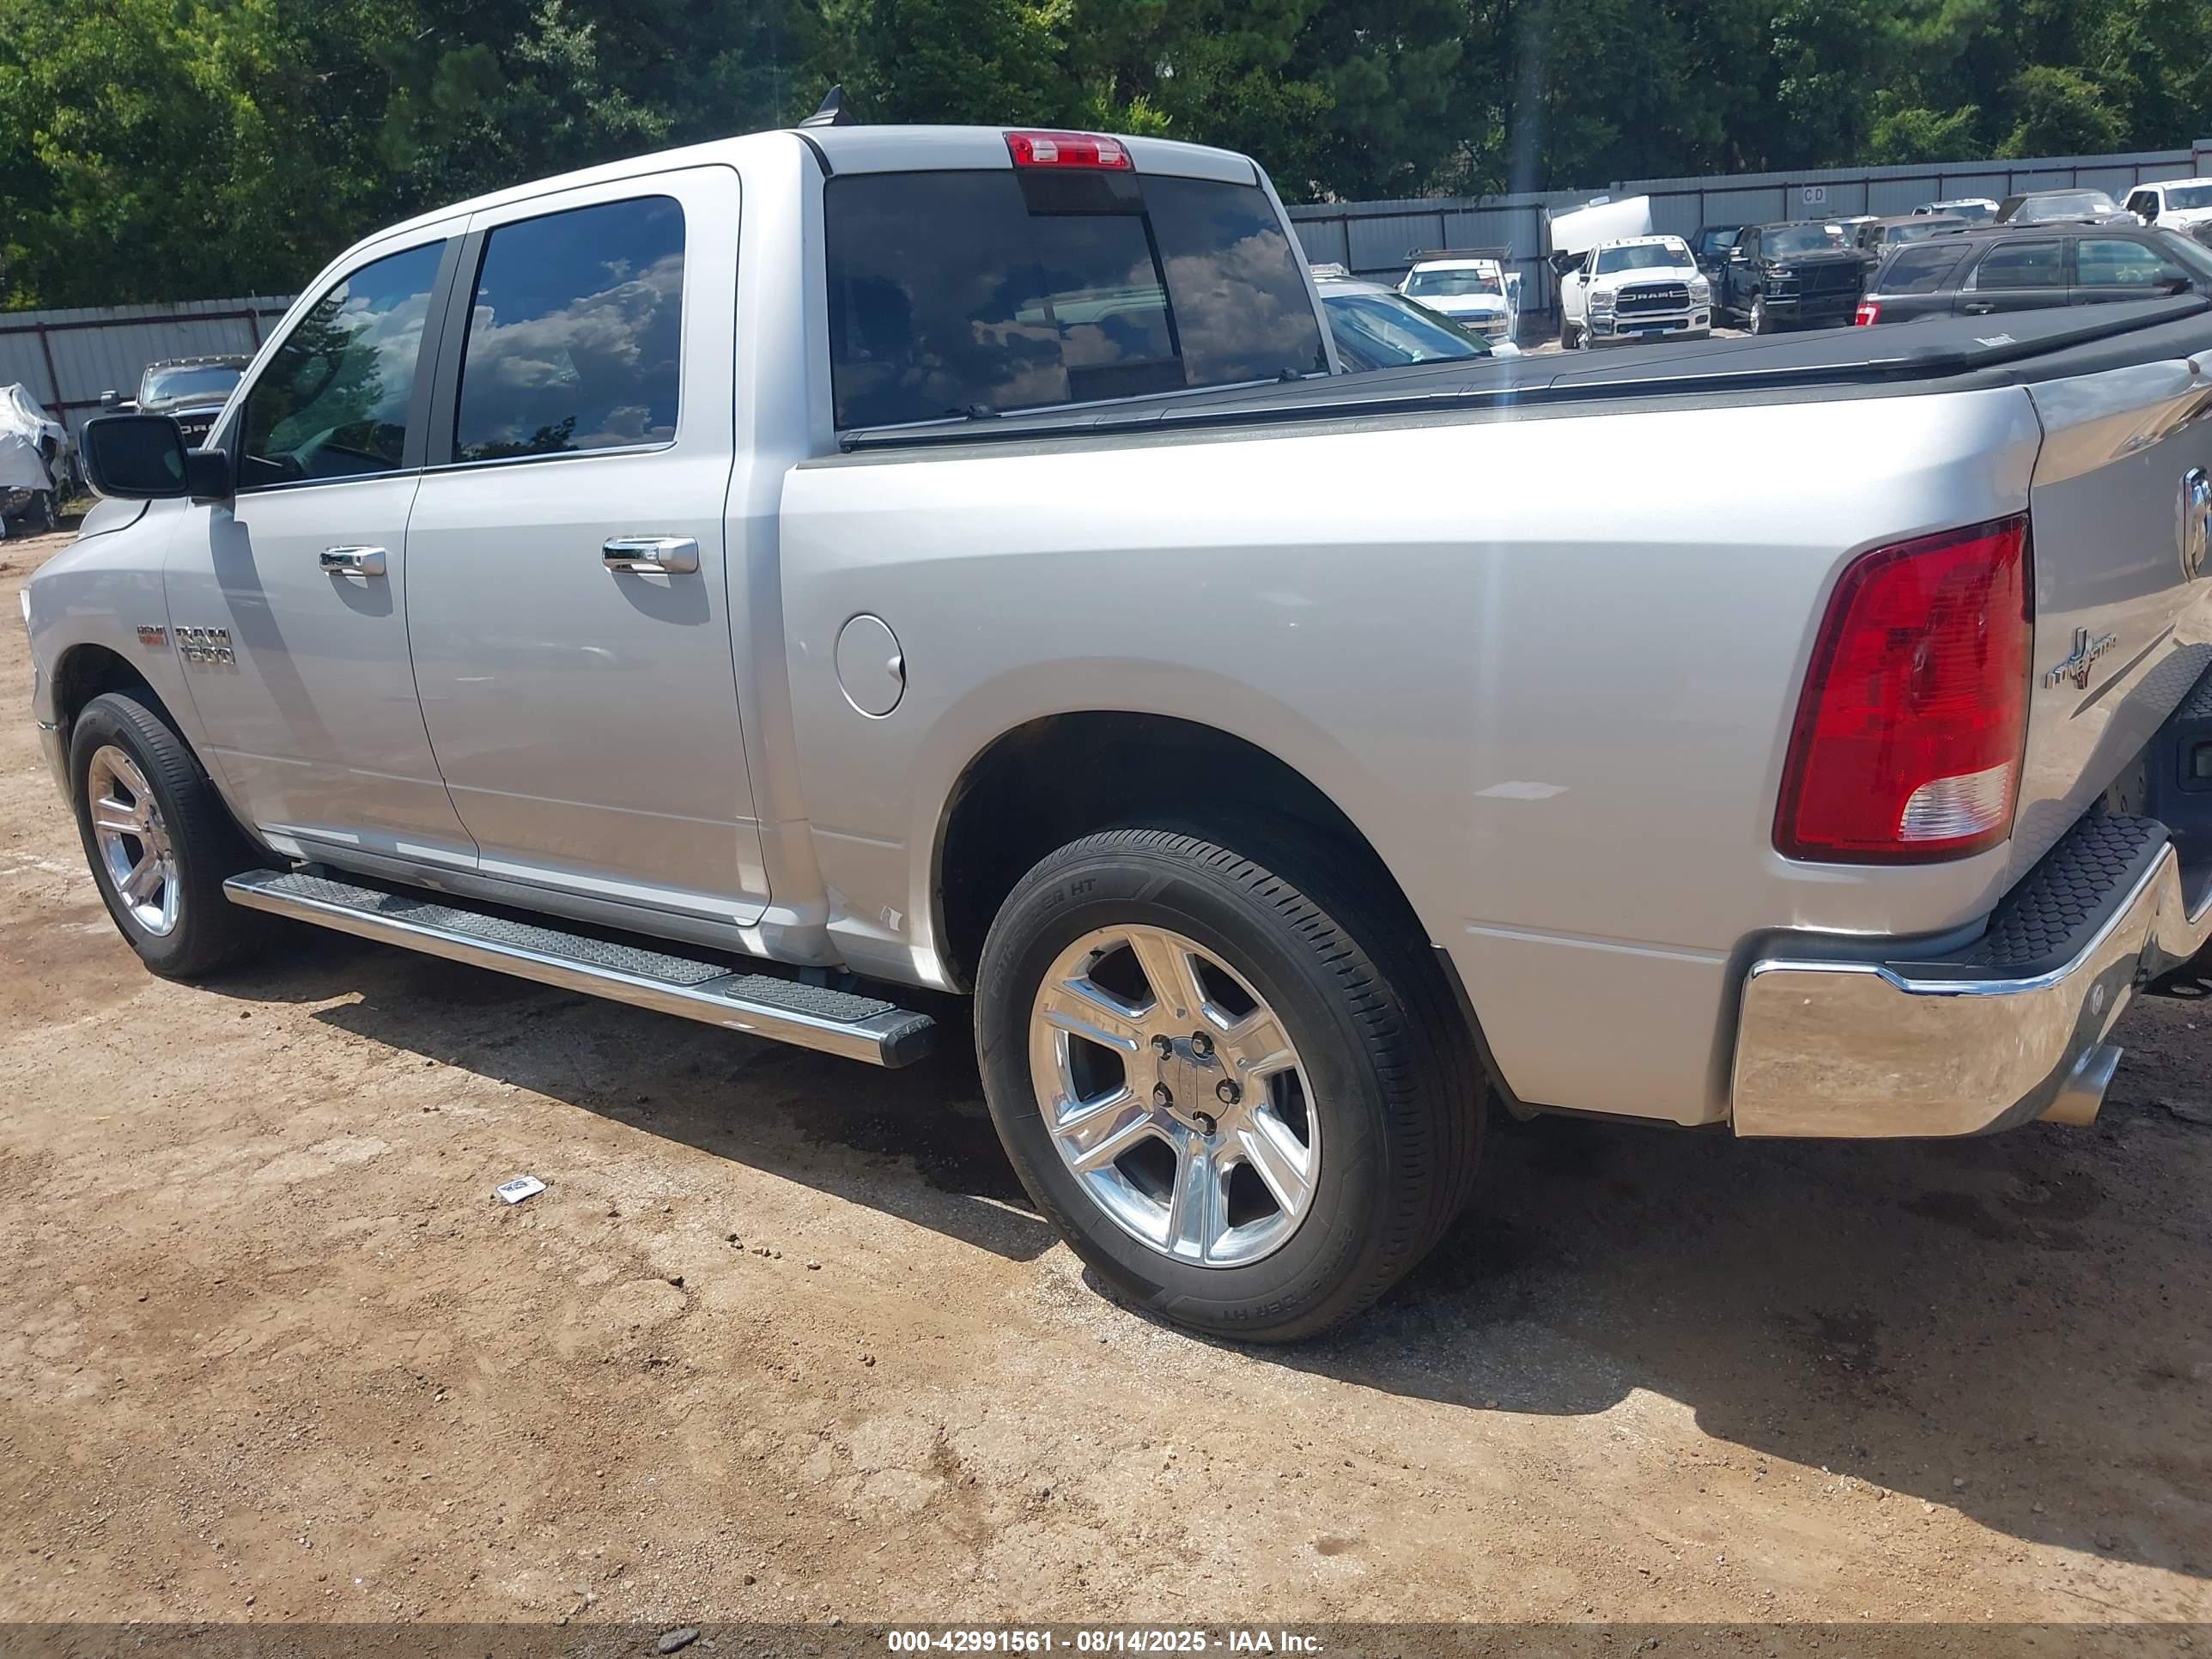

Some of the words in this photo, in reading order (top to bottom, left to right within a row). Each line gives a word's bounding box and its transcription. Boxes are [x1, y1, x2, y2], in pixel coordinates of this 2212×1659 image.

[1638, 291, 1668, 301] RAM
[175, 626, 231, 646] RAM
[179, 646, 235, 666] 1500
[1070, 878, 1097, 896] HT
